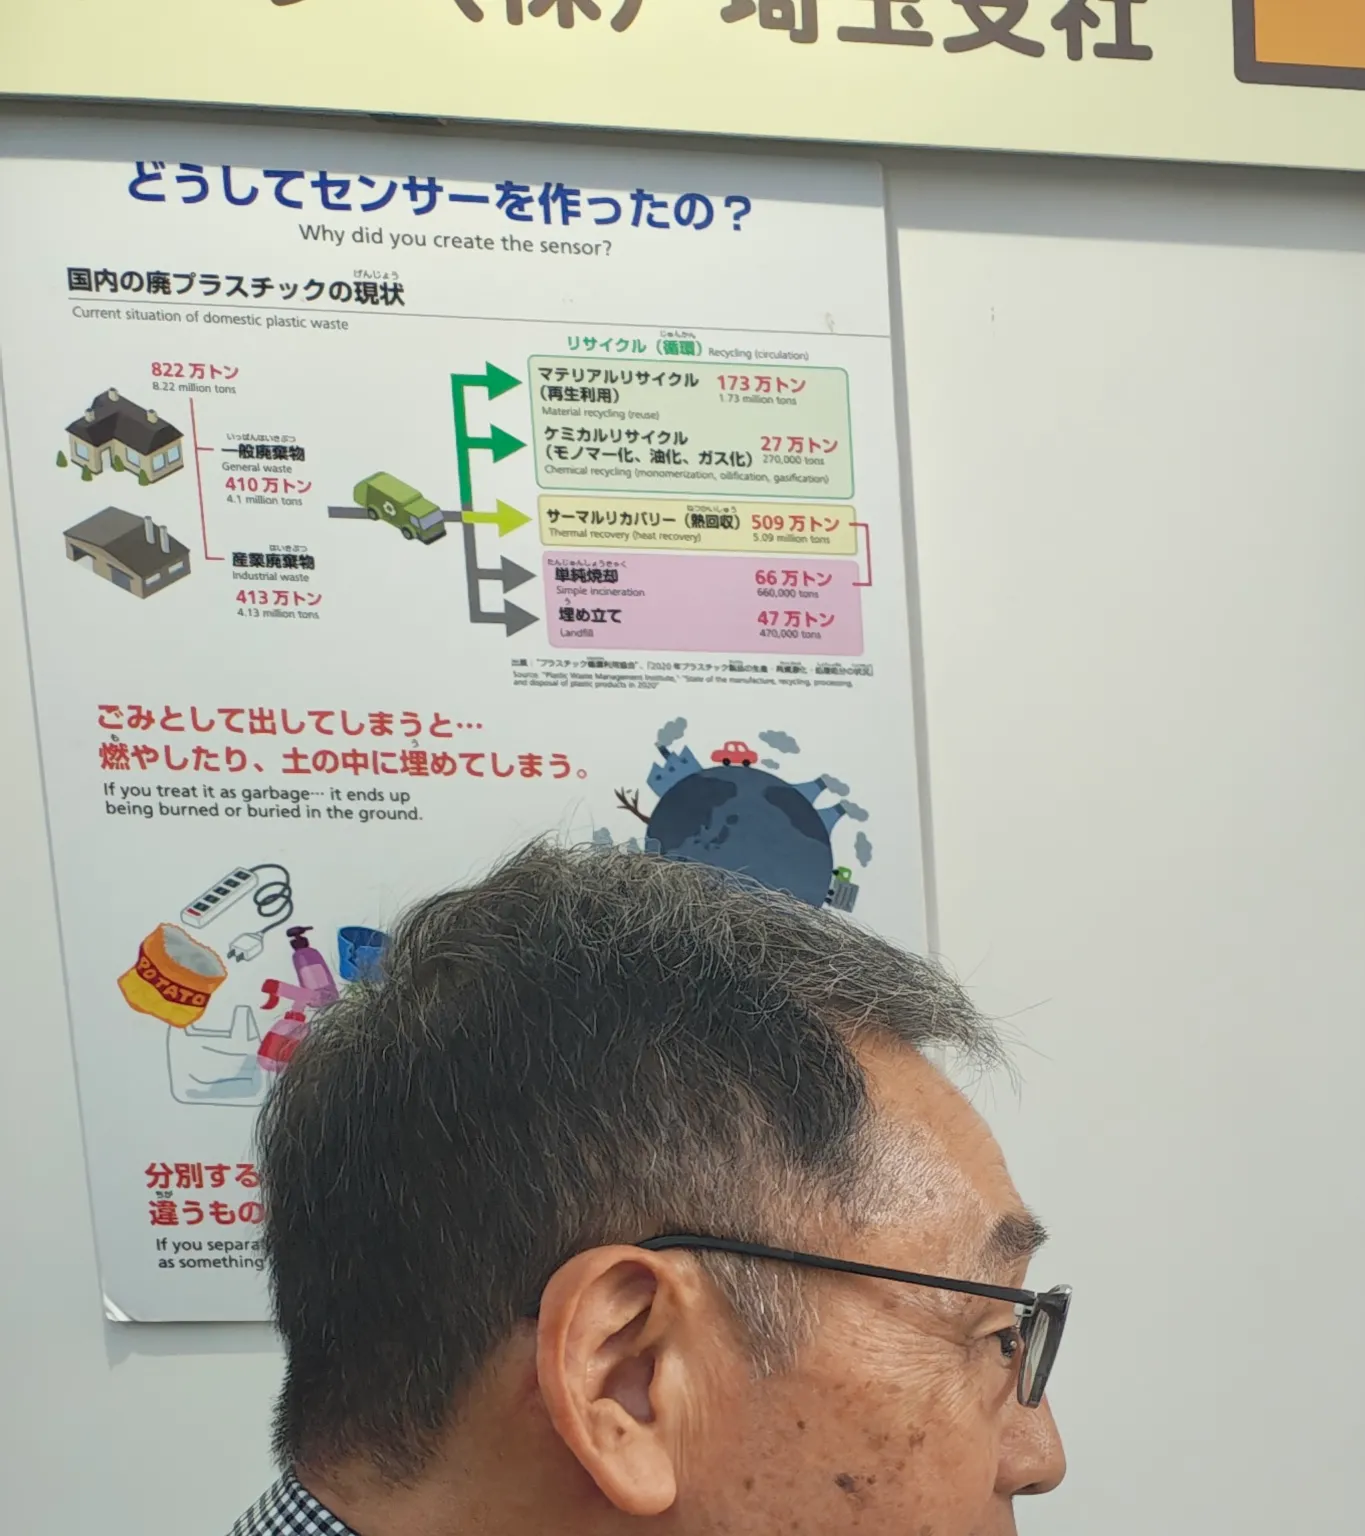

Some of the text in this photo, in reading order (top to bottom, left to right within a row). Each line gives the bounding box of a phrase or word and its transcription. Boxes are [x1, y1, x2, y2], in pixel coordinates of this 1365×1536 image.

[299, 224, 611, 256] Why did you create the sensor?
[72, 306, 348, 330] Current situation of domestic plastic waste
[222, 462, 292, 473] General waste
[233, 571, 309, 582] Industrial waste
[104, 782, 410, 805] If you treat it as garbage… it ends up
[106, 801, 422, 821] being burned or buried in the ground.
[138, 956, 205, 1007] POTATO
[145, 1162, 260, 1188] 分別する
[149, 1200, 266, 1226] 違うもの
[156, 1238, 260, 1254] If you separa
[158, 1258, 175, 1268] as
